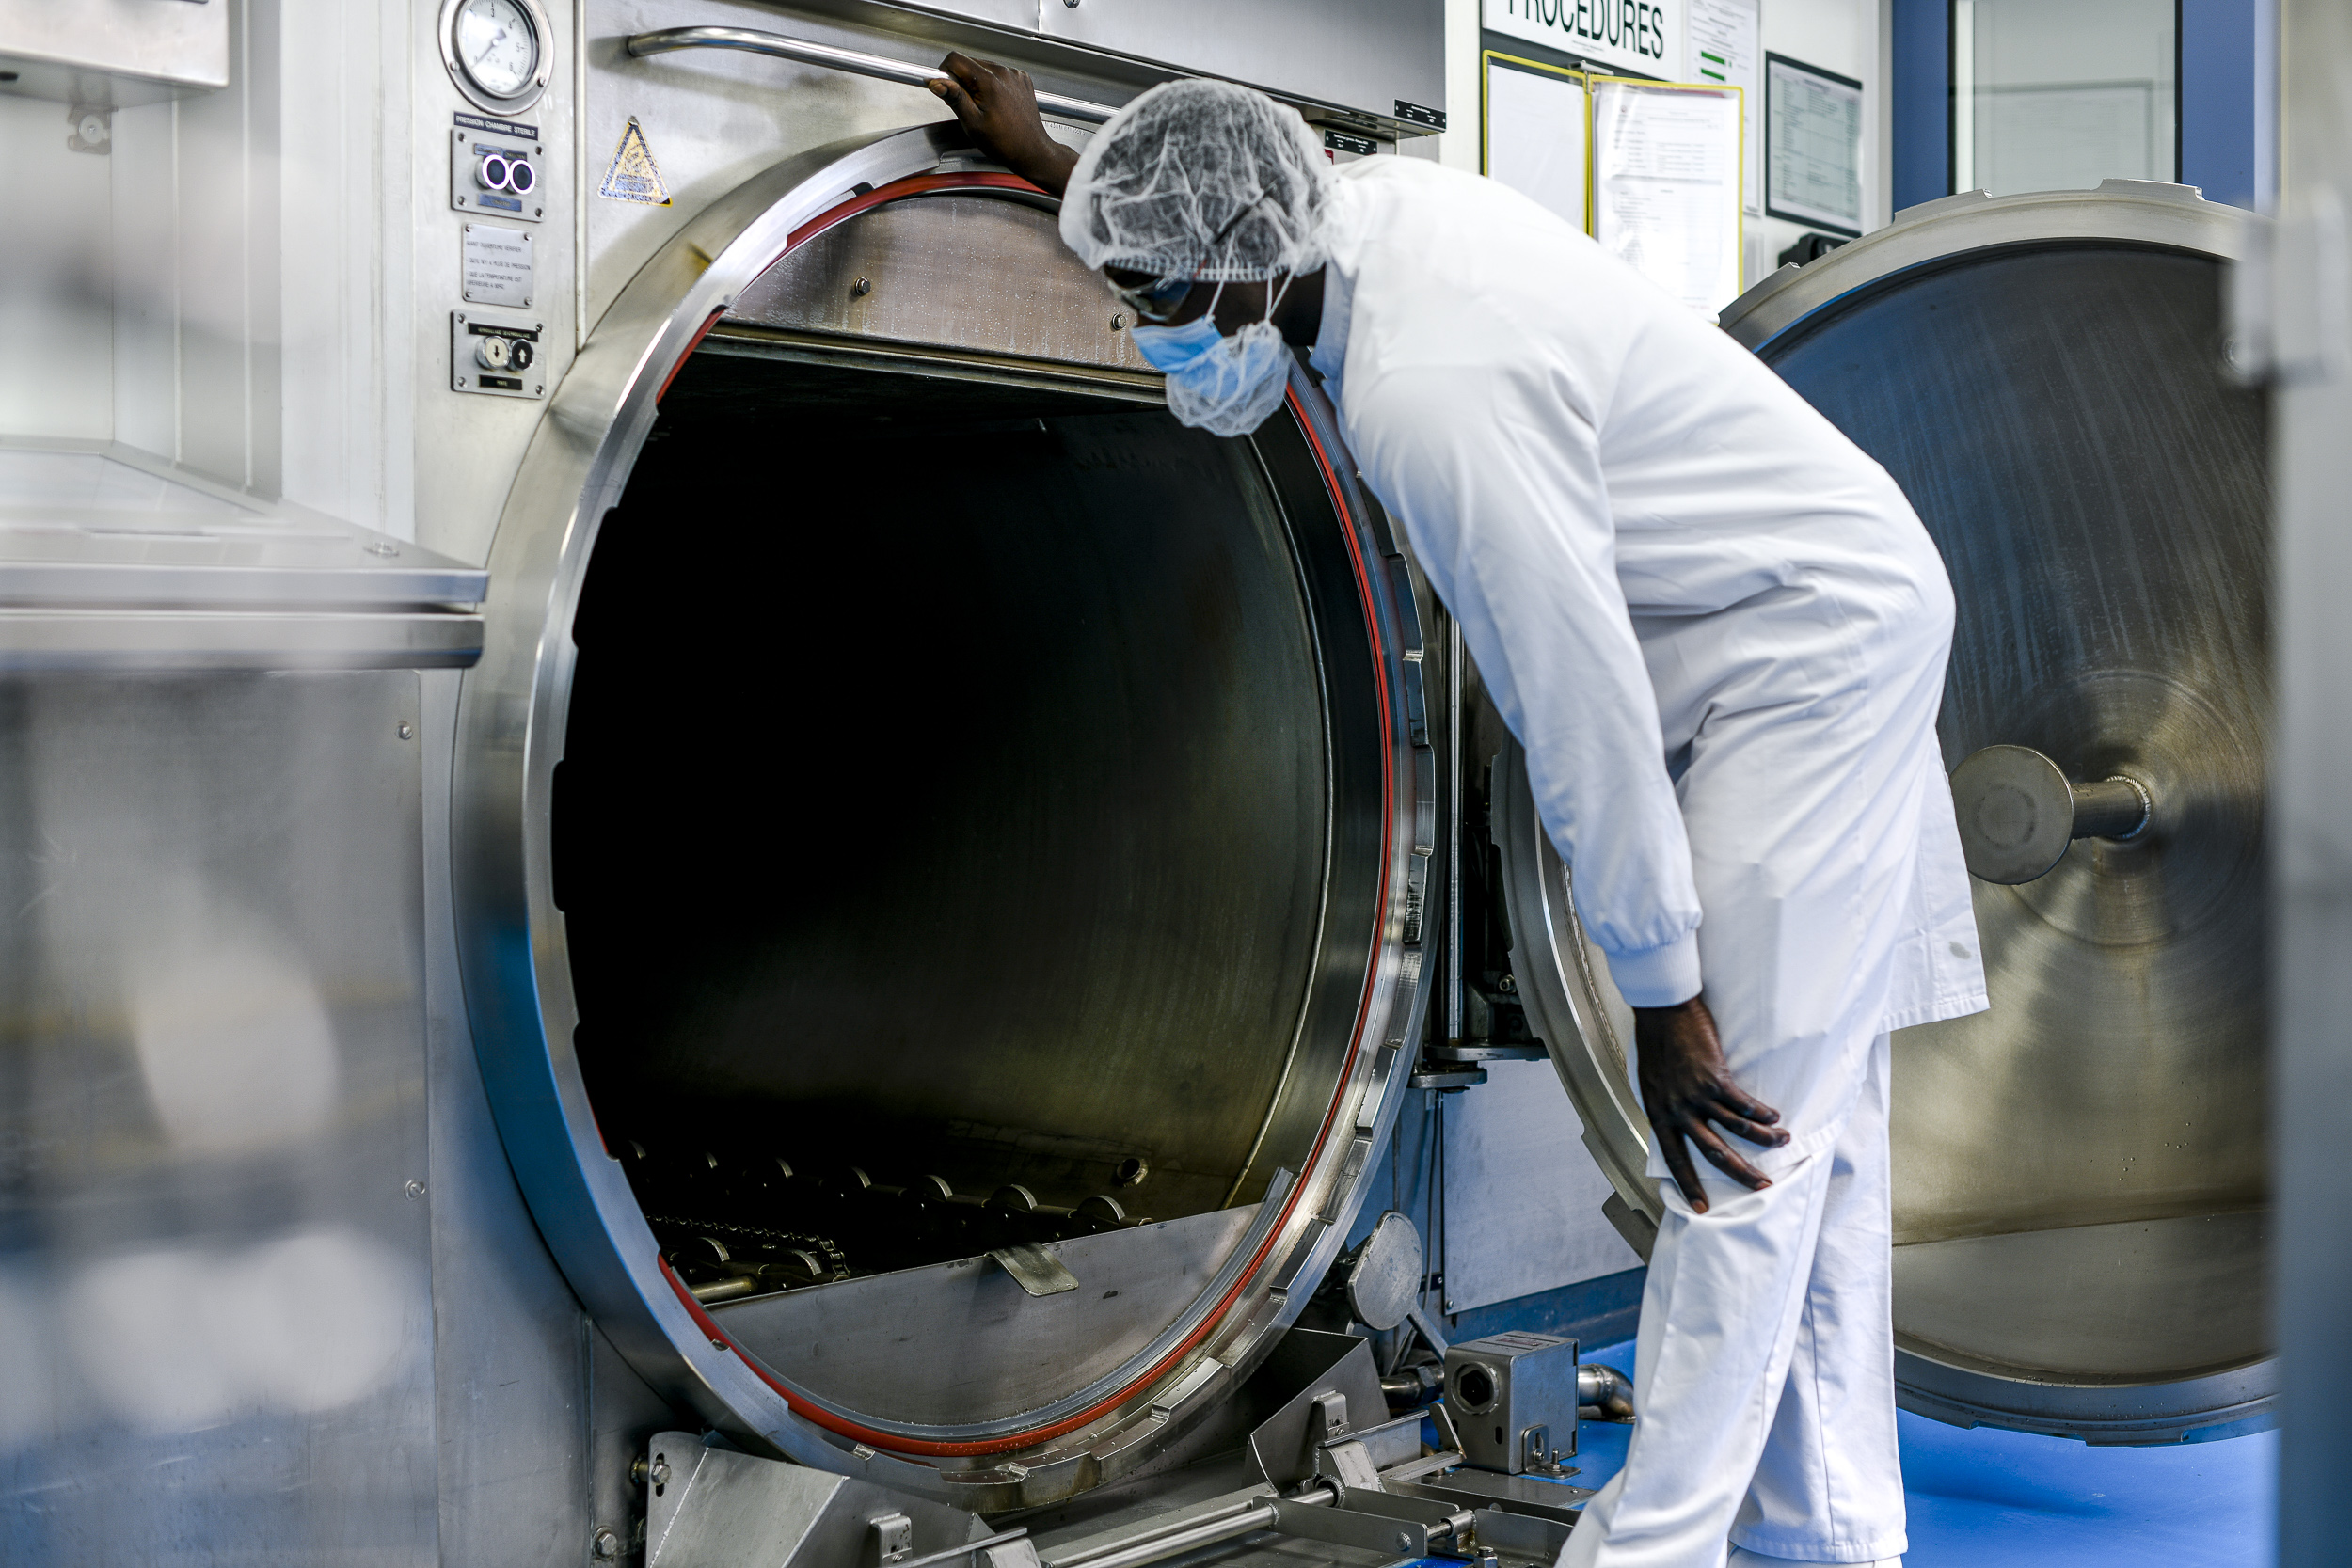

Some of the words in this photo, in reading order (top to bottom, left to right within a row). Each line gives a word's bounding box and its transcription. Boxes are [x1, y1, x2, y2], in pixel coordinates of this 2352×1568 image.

[1509, 0, 1663, 59] OCEDURES
[456, 116, 484, 125] PRESSION
[485, 120, 513, 132] CHAMBRE
[514, 126, 535, 135] STERILE
[485, 273, 513, 281] TEMPERATURE
